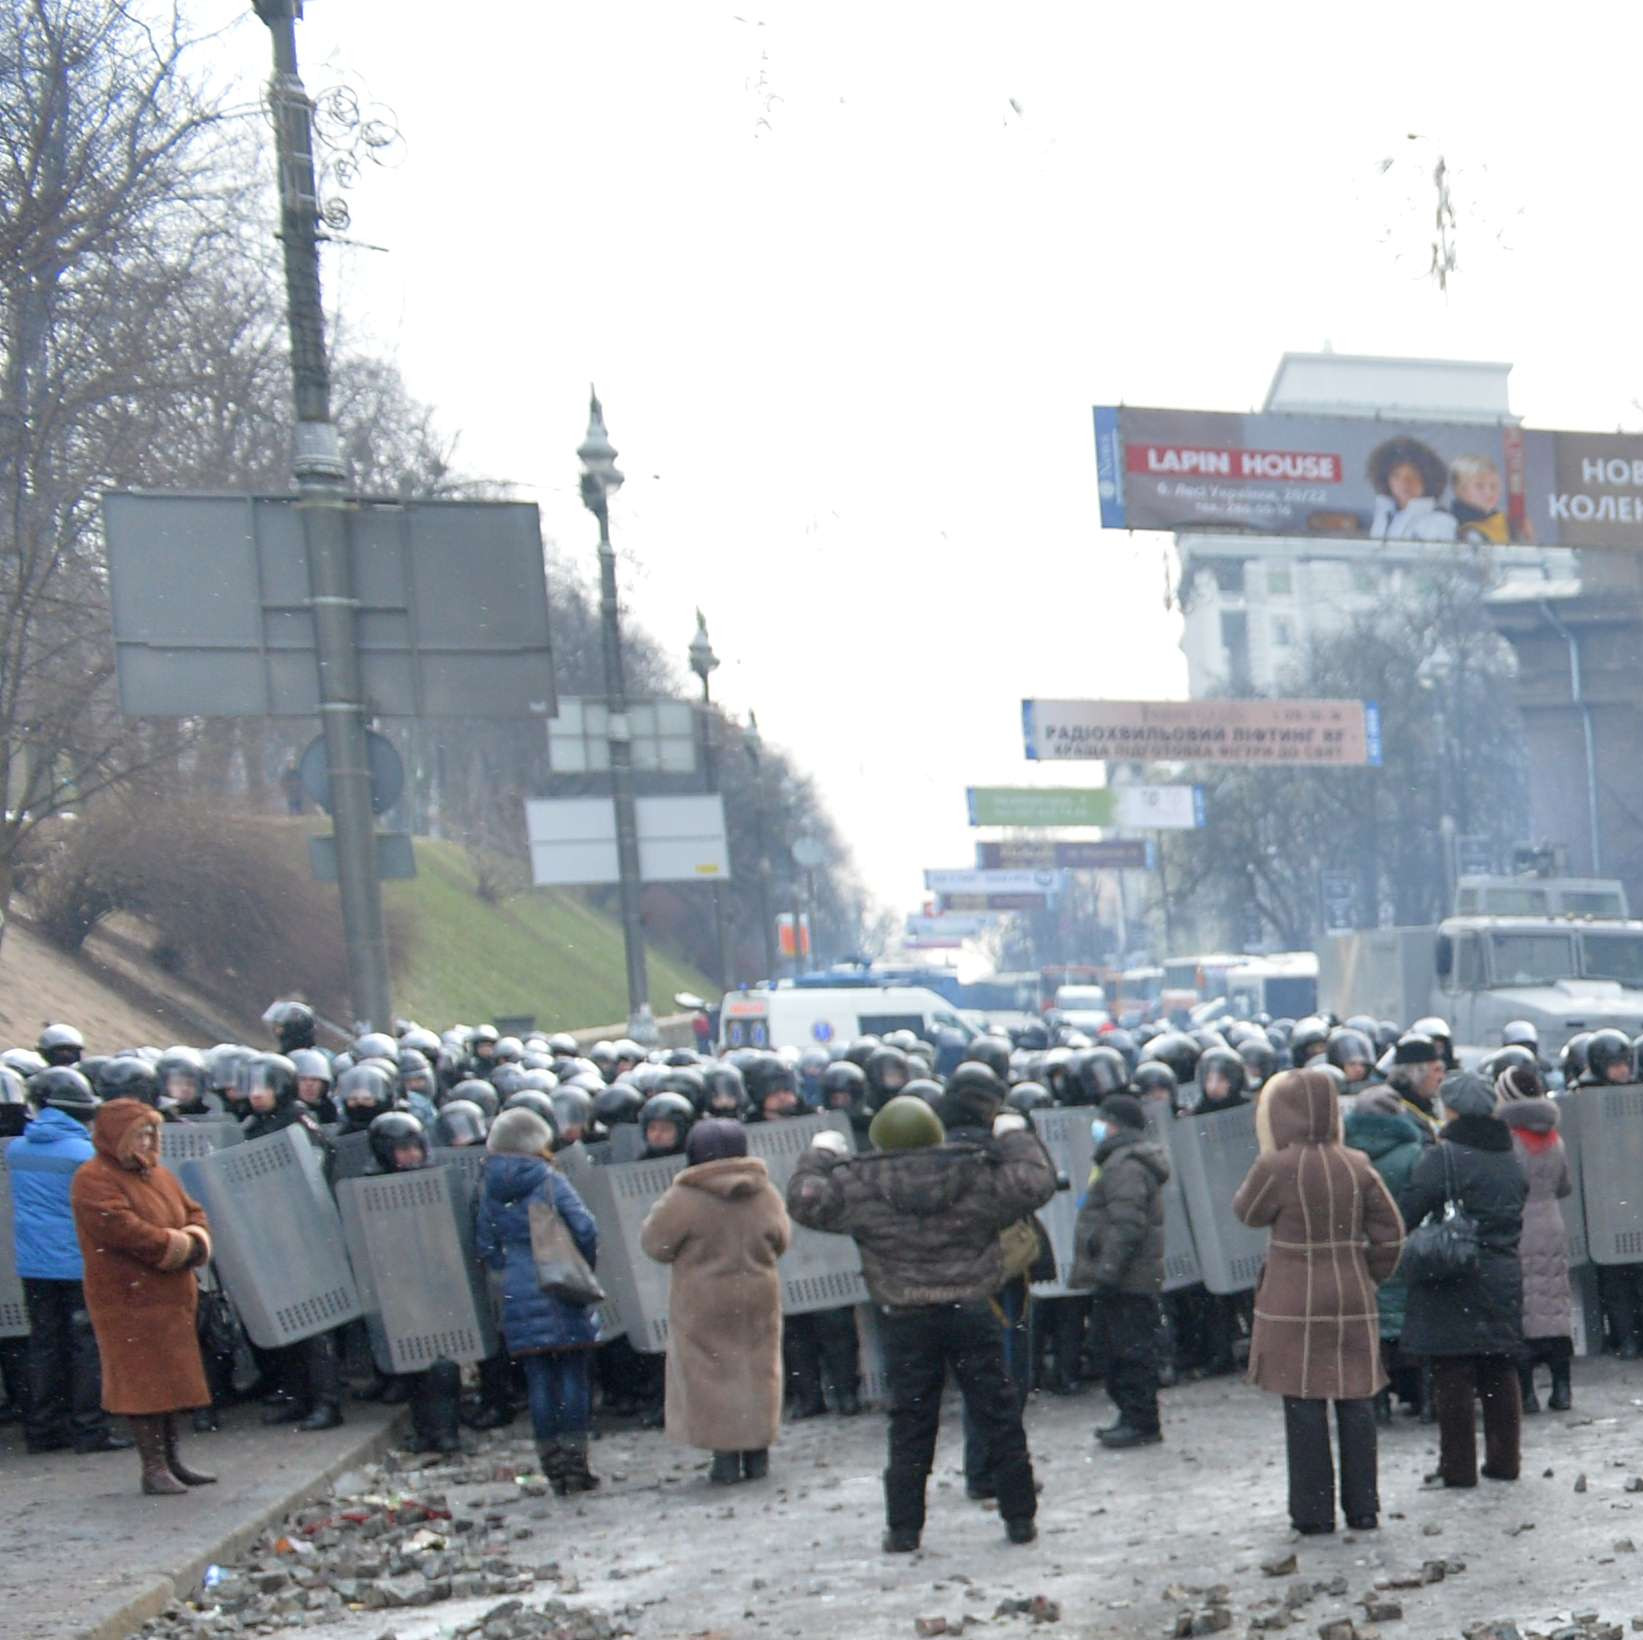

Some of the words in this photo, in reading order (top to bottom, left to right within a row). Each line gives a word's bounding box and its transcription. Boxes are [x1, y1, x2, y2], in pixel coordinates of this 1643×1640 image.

[1148, 449, 1230, 473] LAPIN
[1241, 453, 1334, 480] HOUSE
[1045, 724, 1226, 742] РАДІОХВИЛЬОВИЙ
